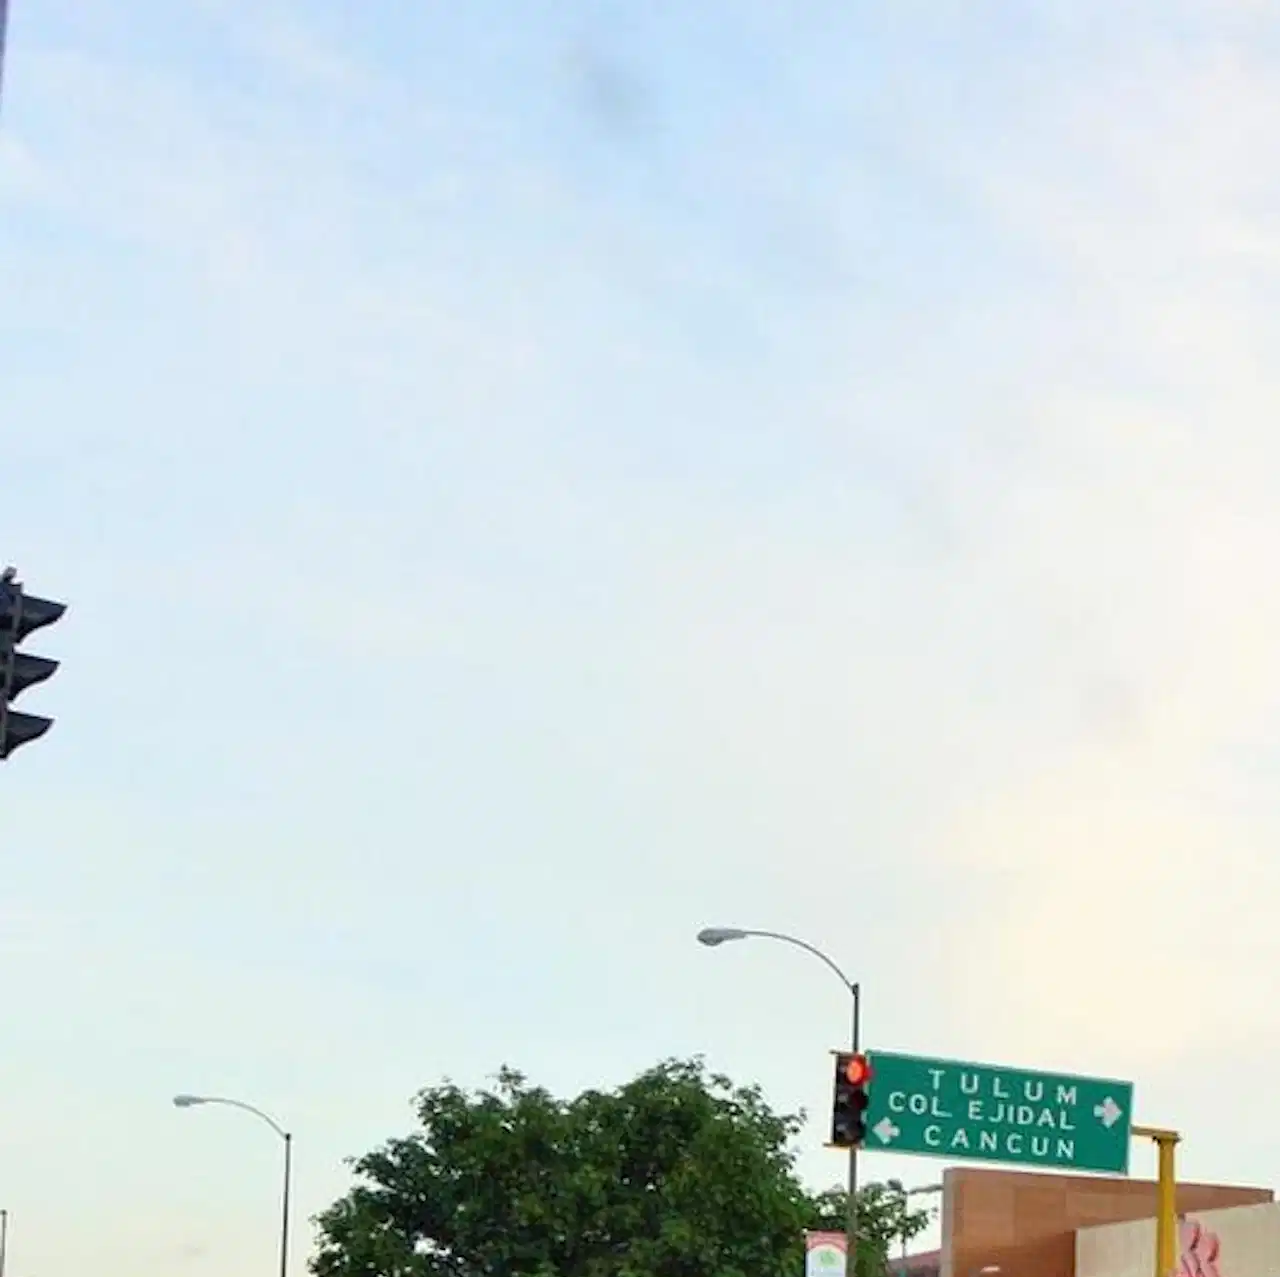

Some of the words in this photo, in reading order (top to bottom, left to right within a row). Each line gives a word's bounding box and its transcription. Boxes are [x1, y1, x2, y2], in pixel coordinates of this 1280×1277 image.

[928, 1069, 1077, 1105] TULUM
[888, 1091, 952, 1117] COL
[967, 1101, 1076, 1130] EJIDAL
[923, 1125, 1075, 1159] CANCUN
